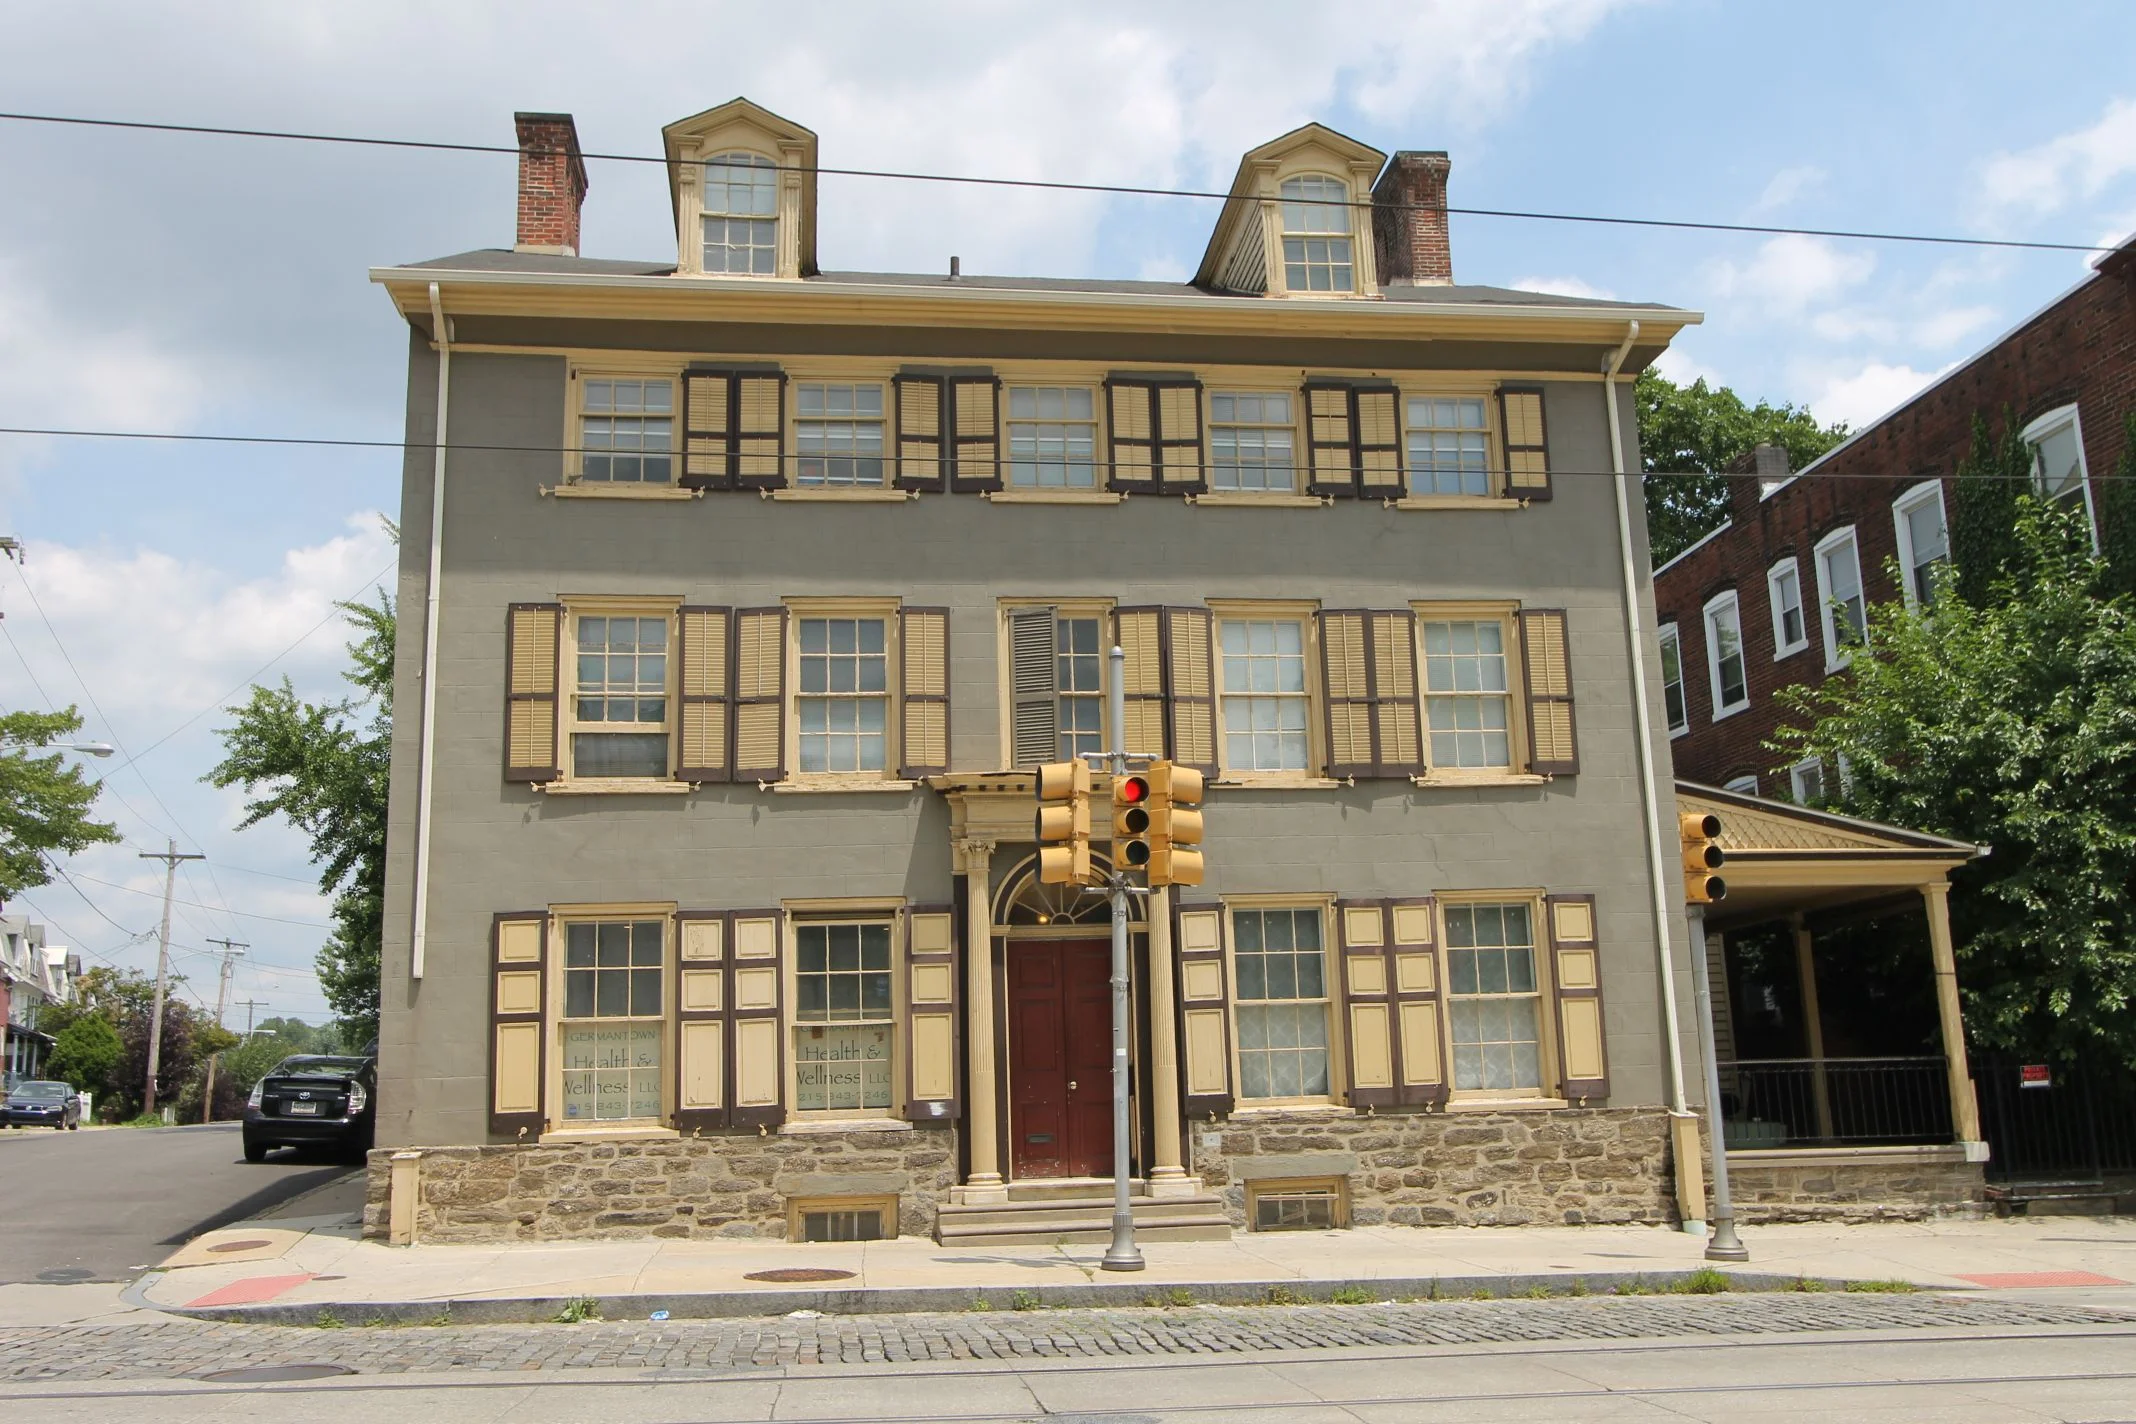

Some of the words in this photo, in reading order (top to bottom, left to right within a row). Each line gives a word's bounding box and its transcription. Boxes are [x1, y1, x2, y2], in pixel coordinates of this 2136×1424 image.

[570, 1030, 656, 1042] GERMANTOWN
[574, 1048, 630, 1069] Health
[637, 1053, 652, 1068] &
[805, 1040, 860, 1060] Health
[866, 1044, 881, 1060] &
